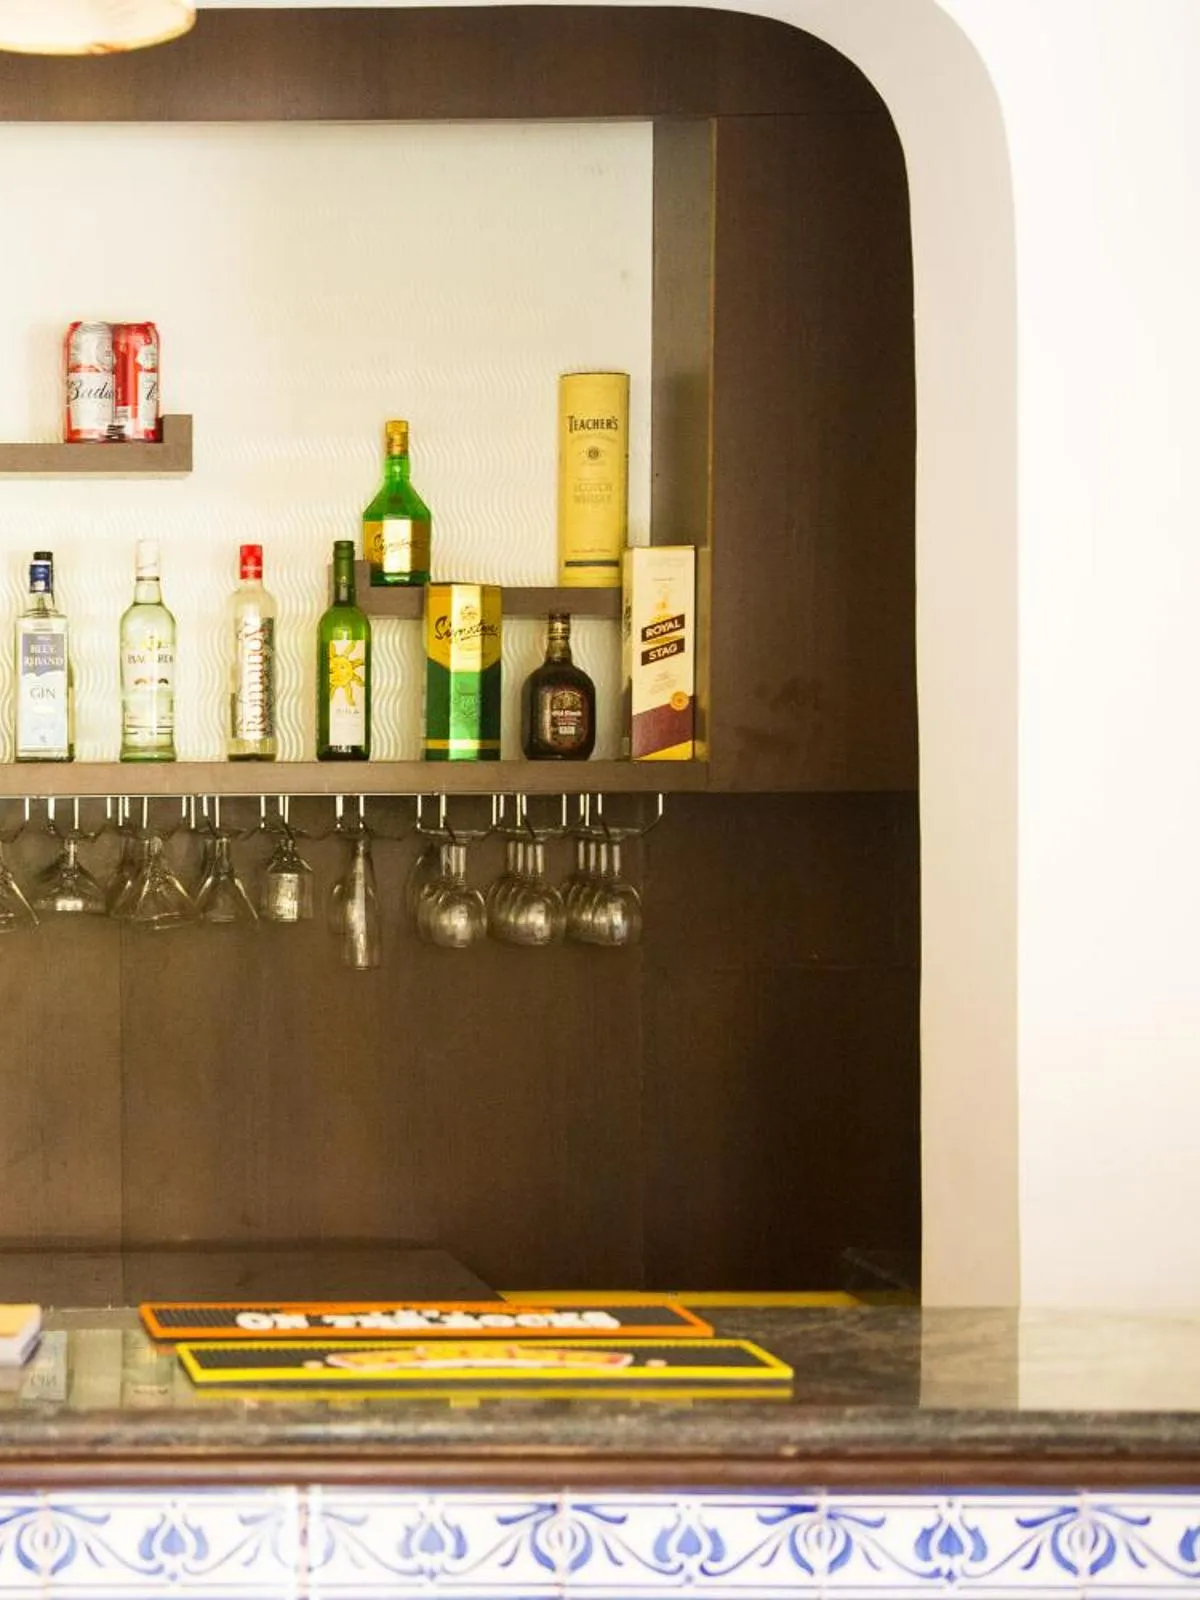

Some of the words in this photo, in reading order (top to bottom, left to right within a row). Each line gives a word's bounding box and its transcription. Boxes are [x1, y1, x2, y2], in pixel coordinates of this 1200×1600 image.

[567, 415, 619, 433] TEACHER'S
[645, 619, 681, 640] ROYAL
[648, 643, 678, 660] STAG
[30, 687, 56, 699] GIN
